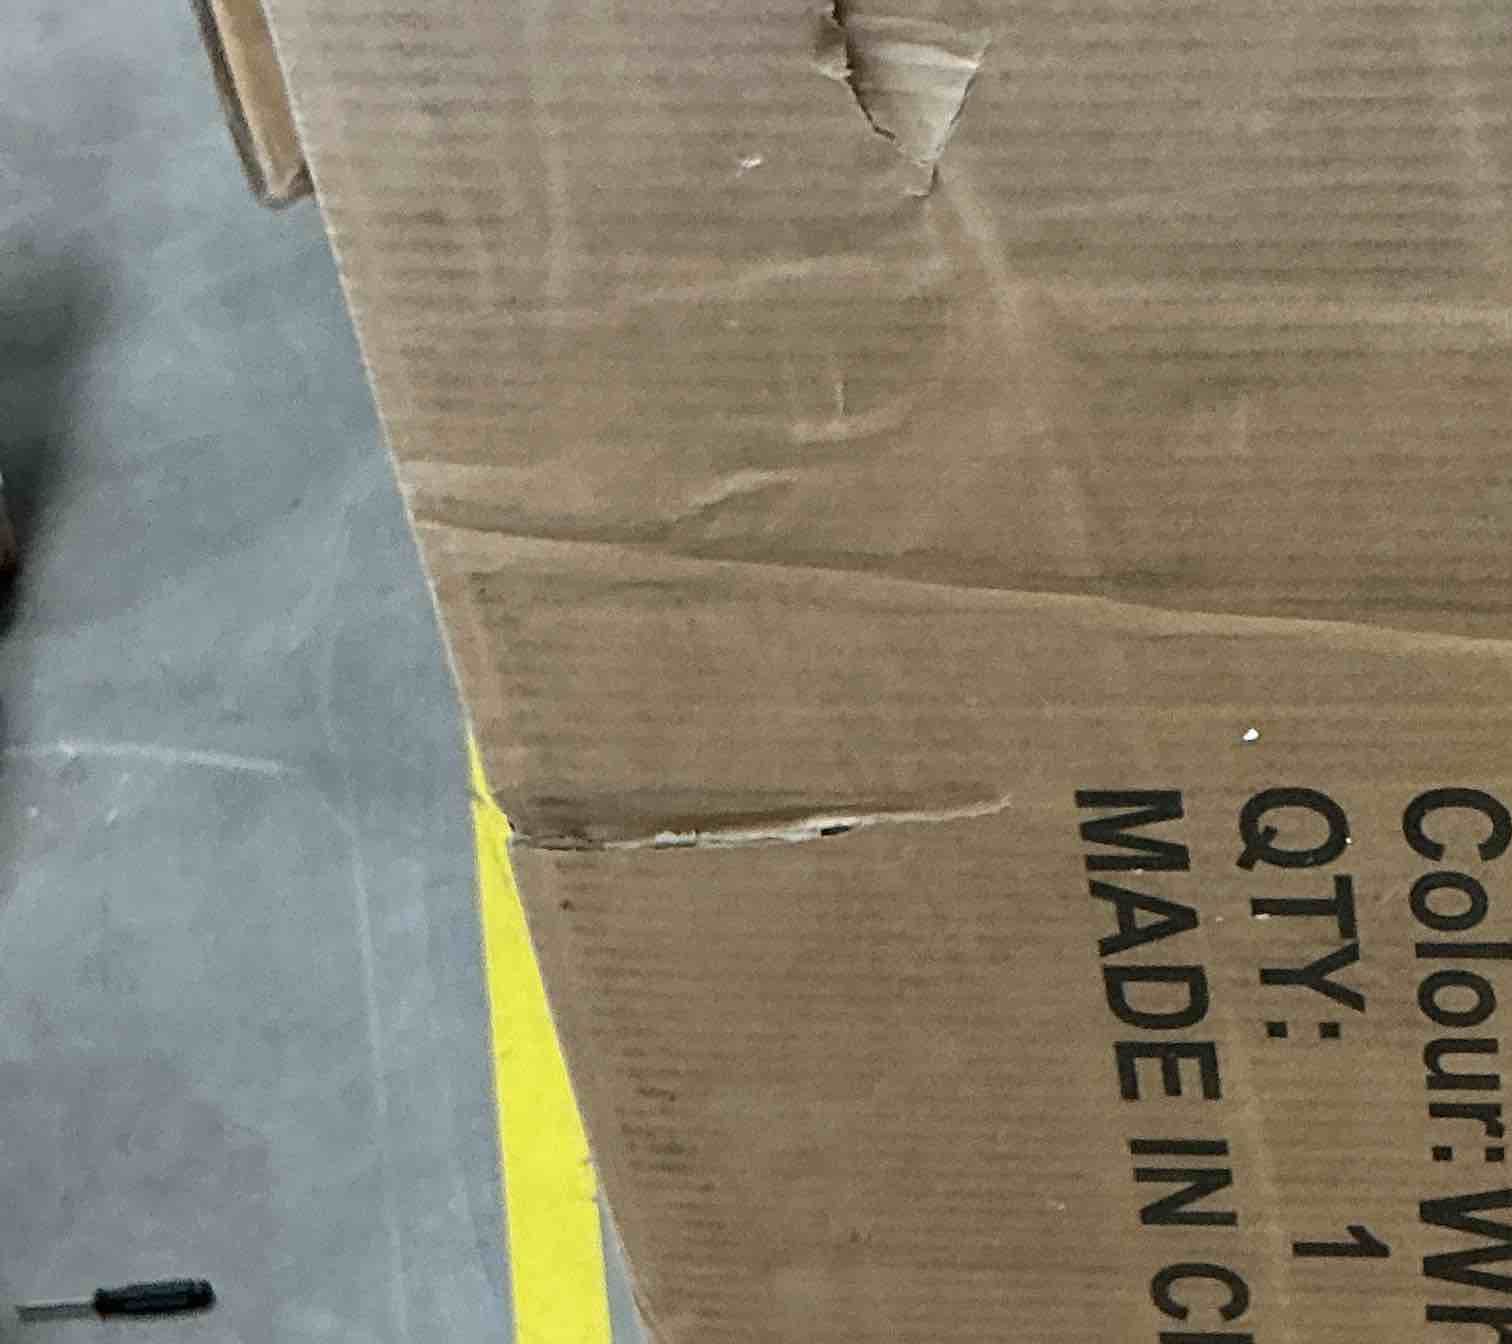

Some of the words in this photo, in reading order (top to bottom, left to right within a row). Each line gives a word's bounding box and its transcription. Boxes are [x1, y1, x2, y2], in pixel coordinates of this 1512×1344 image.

[1074, 788, 1223, 1103] MADE
[1235, 786, 1367, 1040] QTY:
[1128, 1137, 1239, 1228] IN
[1291, 1224, 1391, 1258] 1
